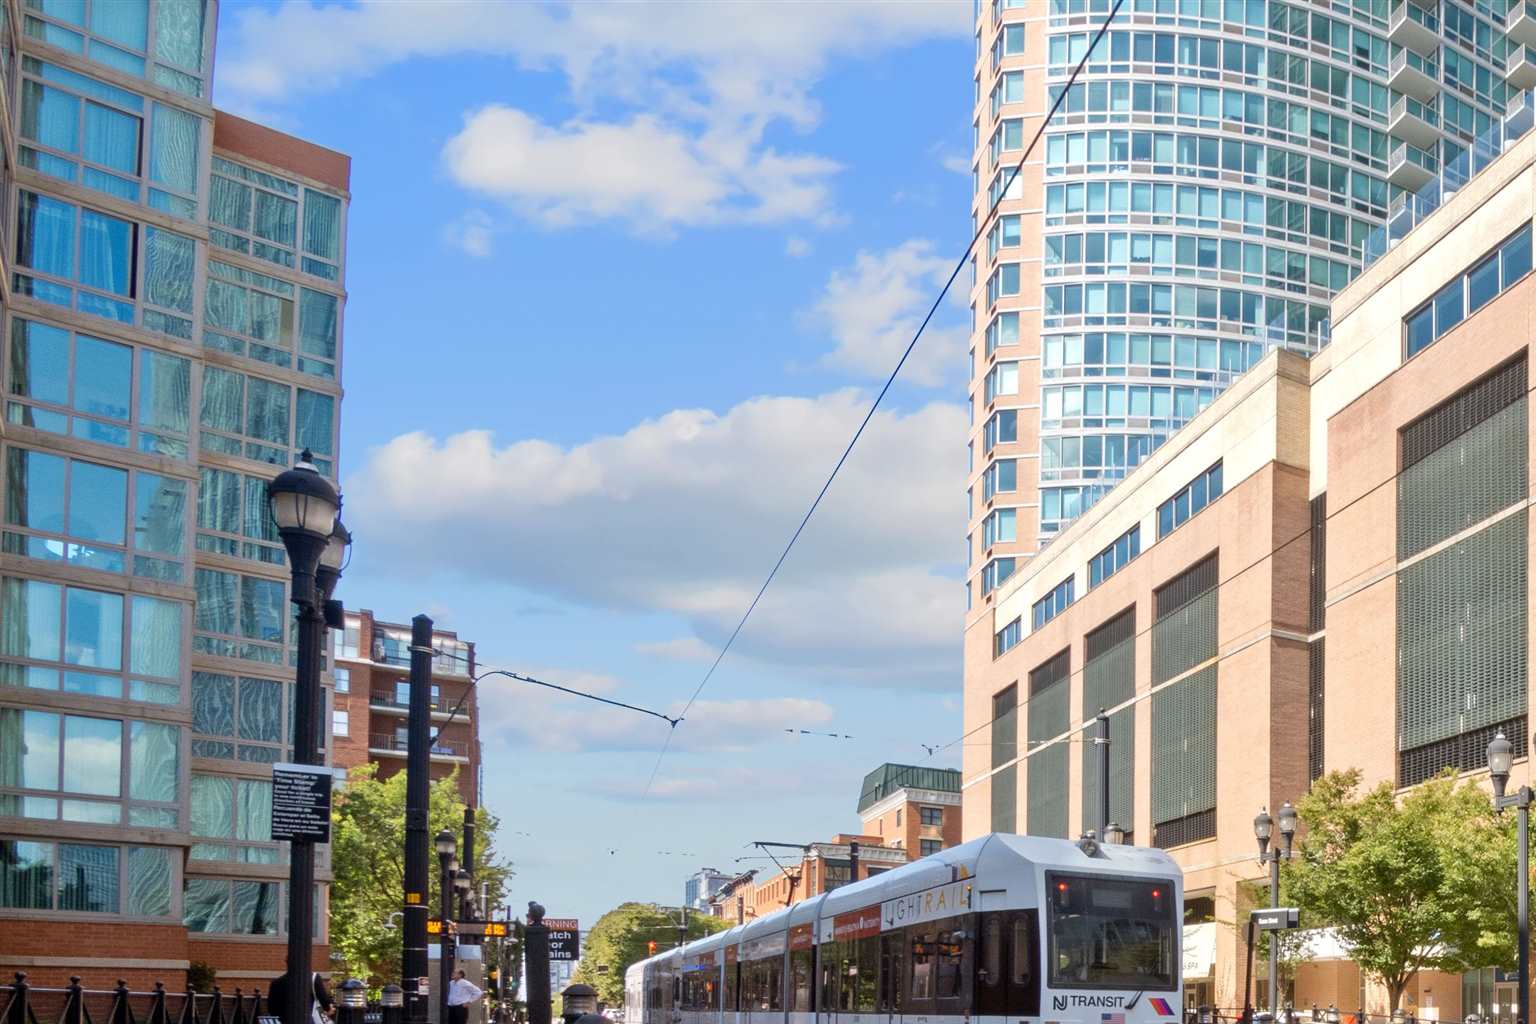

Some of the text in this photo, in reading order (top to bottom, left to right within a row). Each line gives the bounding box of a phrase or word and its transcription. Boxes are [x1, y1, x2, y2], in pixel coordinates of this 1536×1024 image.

[544, 920, 577, 928] RNING
[1053, 995, 1125, 1011] NJ TRANSIT
